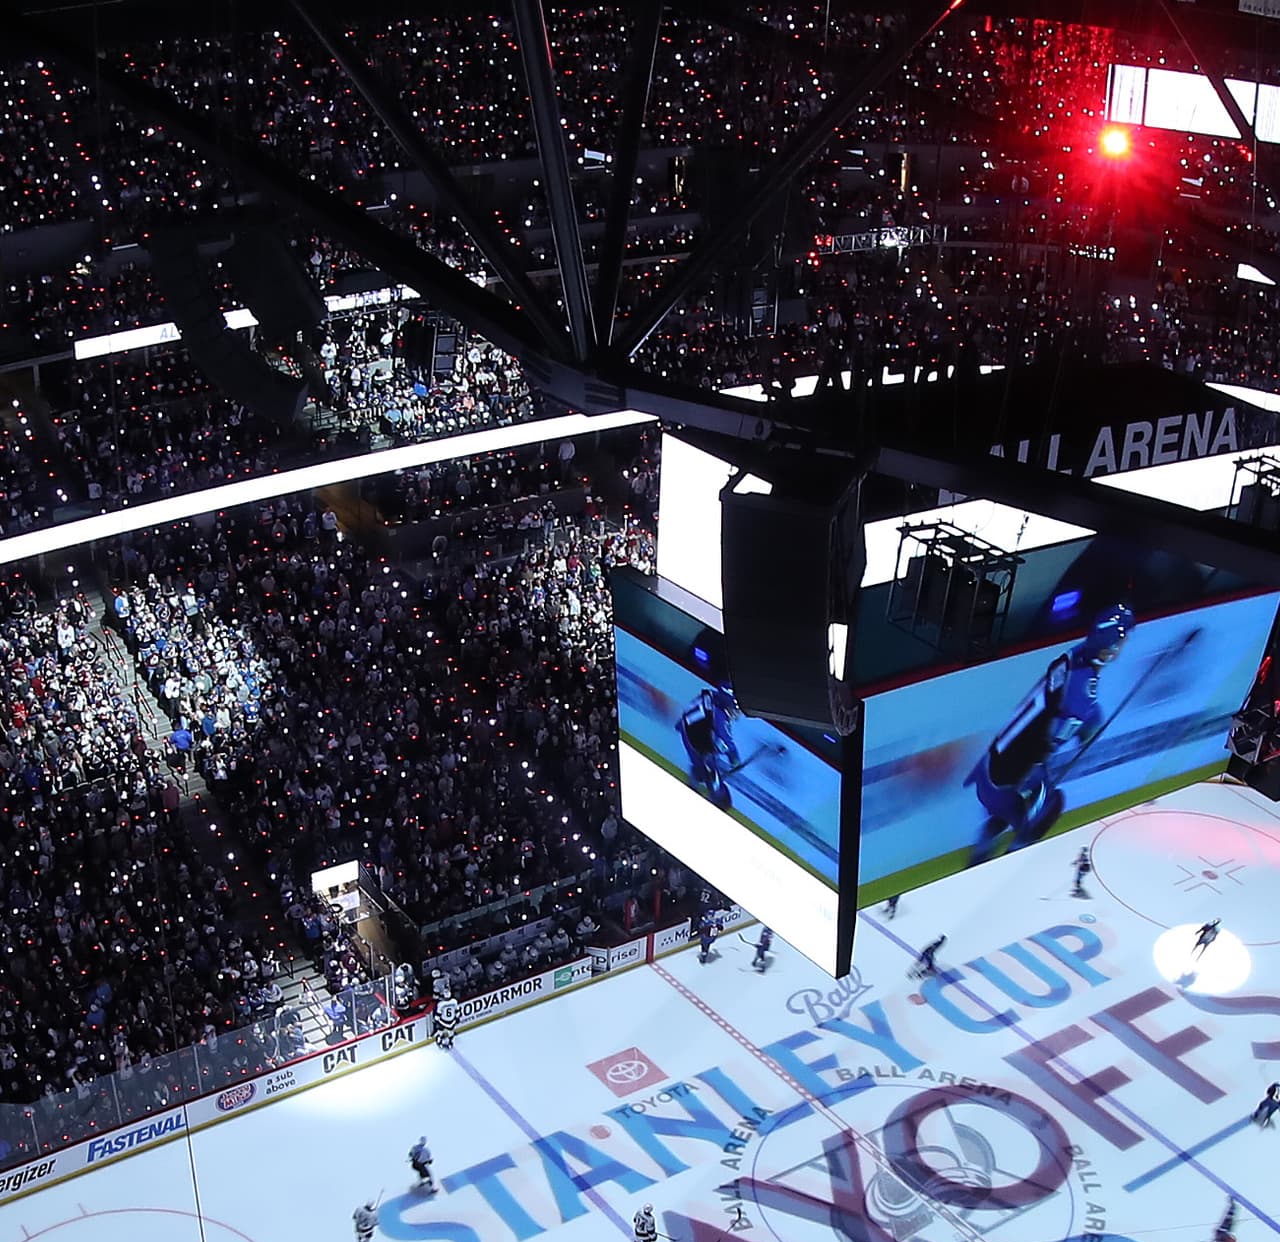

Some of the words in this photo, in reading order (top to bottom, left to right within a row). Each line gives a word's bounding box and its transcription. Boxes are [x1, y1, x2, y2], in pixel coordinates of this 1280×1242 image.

[1082, 407, 1238, 477] ARENA
[785, 965, 874, 1026] Ball
[919, 922, 1115, 1034] CUP
[445, 1007, 452, 1017] 6
[322, 1044, 358, 1074] CAT
[381, 1022, 416, 1052] CAT
[265, 1079, 296, 1095] above
[275, 1070, 294, 1083] sub
[835, 1064, 908, 1084] BALL
[917, 1067, 1014, 1108] ARENA
[616, 1081, 701, 1121] TOYOTA
[86, 1113, 187, 1163] FASTENAL
[719, 1105, 774, 1172] ARENA
[1067, 1144, 1103, 1196] BALL
[720, 1179, 755, 1234] BALL
